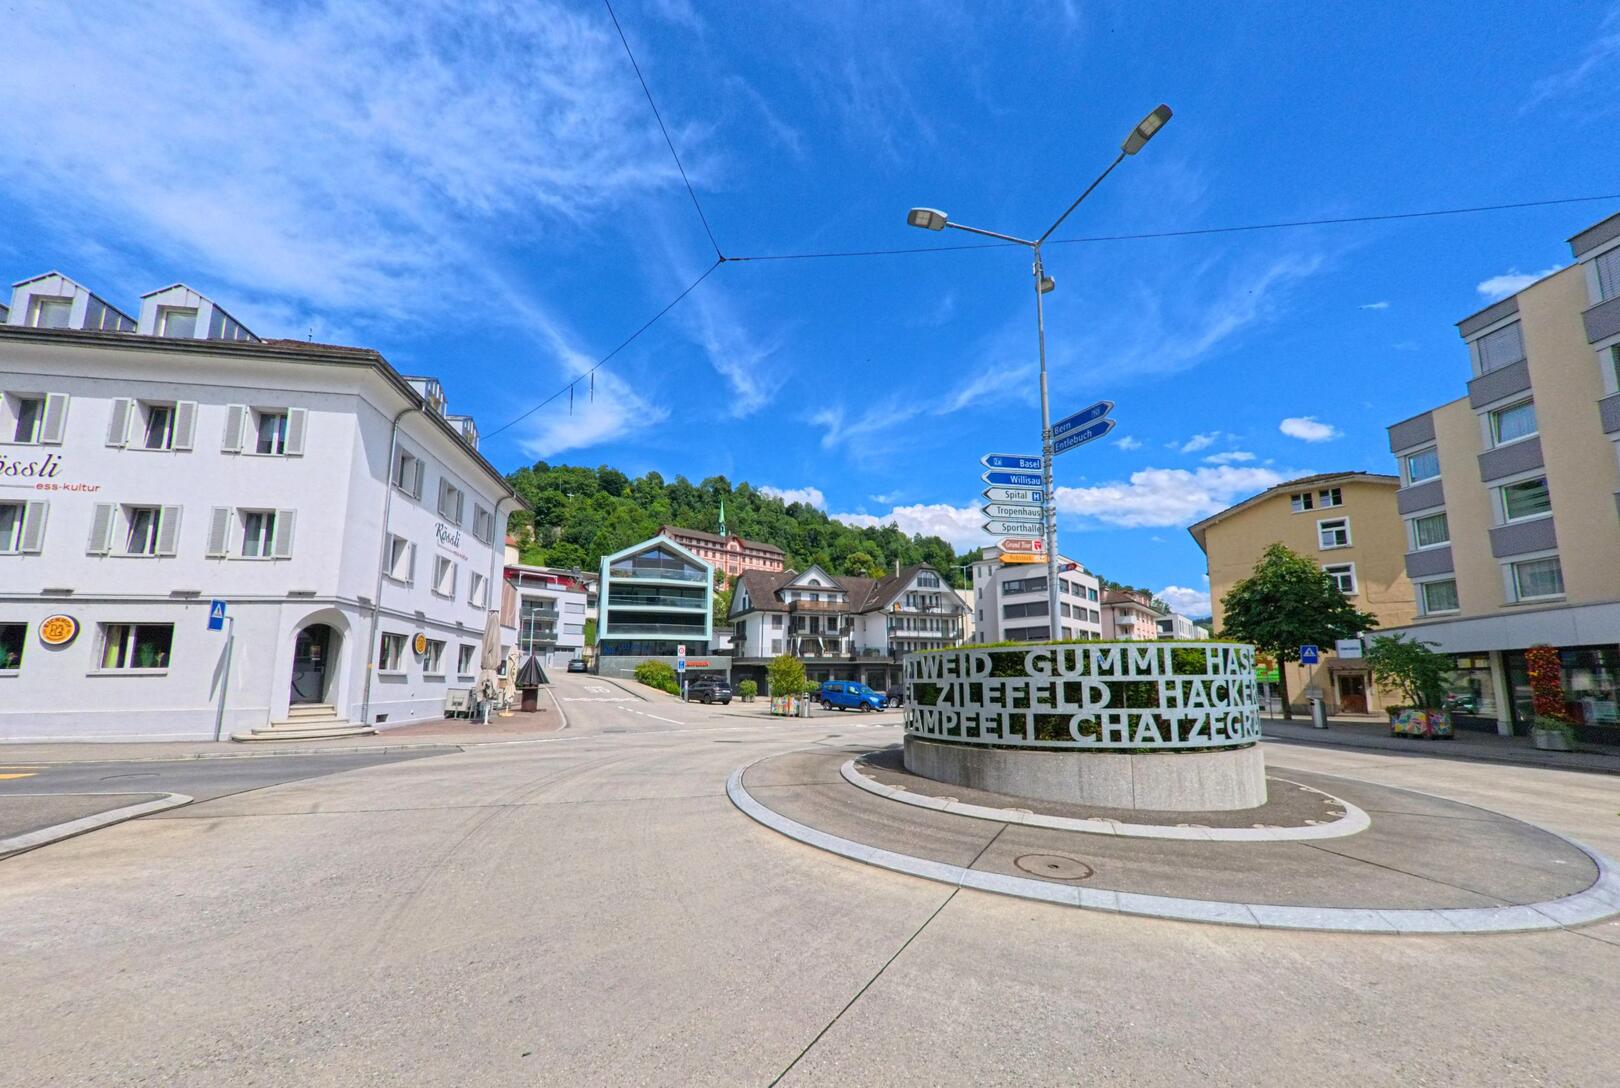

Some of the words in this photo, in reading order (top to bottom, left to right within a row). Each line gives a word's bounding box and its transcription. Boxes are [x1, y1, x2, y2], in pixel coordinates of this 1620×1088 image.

[1054, 422, 1071, 434] Bern
[1055, 429, 1093, 451] Entlebuch
[1019, 458, 1040, 469] Basel
[1010, 475, 1041, 485] Willisau
[36, 482, 100, 492] ess-kultur
[1005, 490, 1028, 500] Spital
[997, 506, 1041, 517] Tropenhaus
[1002, 523, 1042, 533] Sporthalle
[1024, 647, 1173, 678] GUMMI
[936, 680, 1111, 709] ZILEFELD
